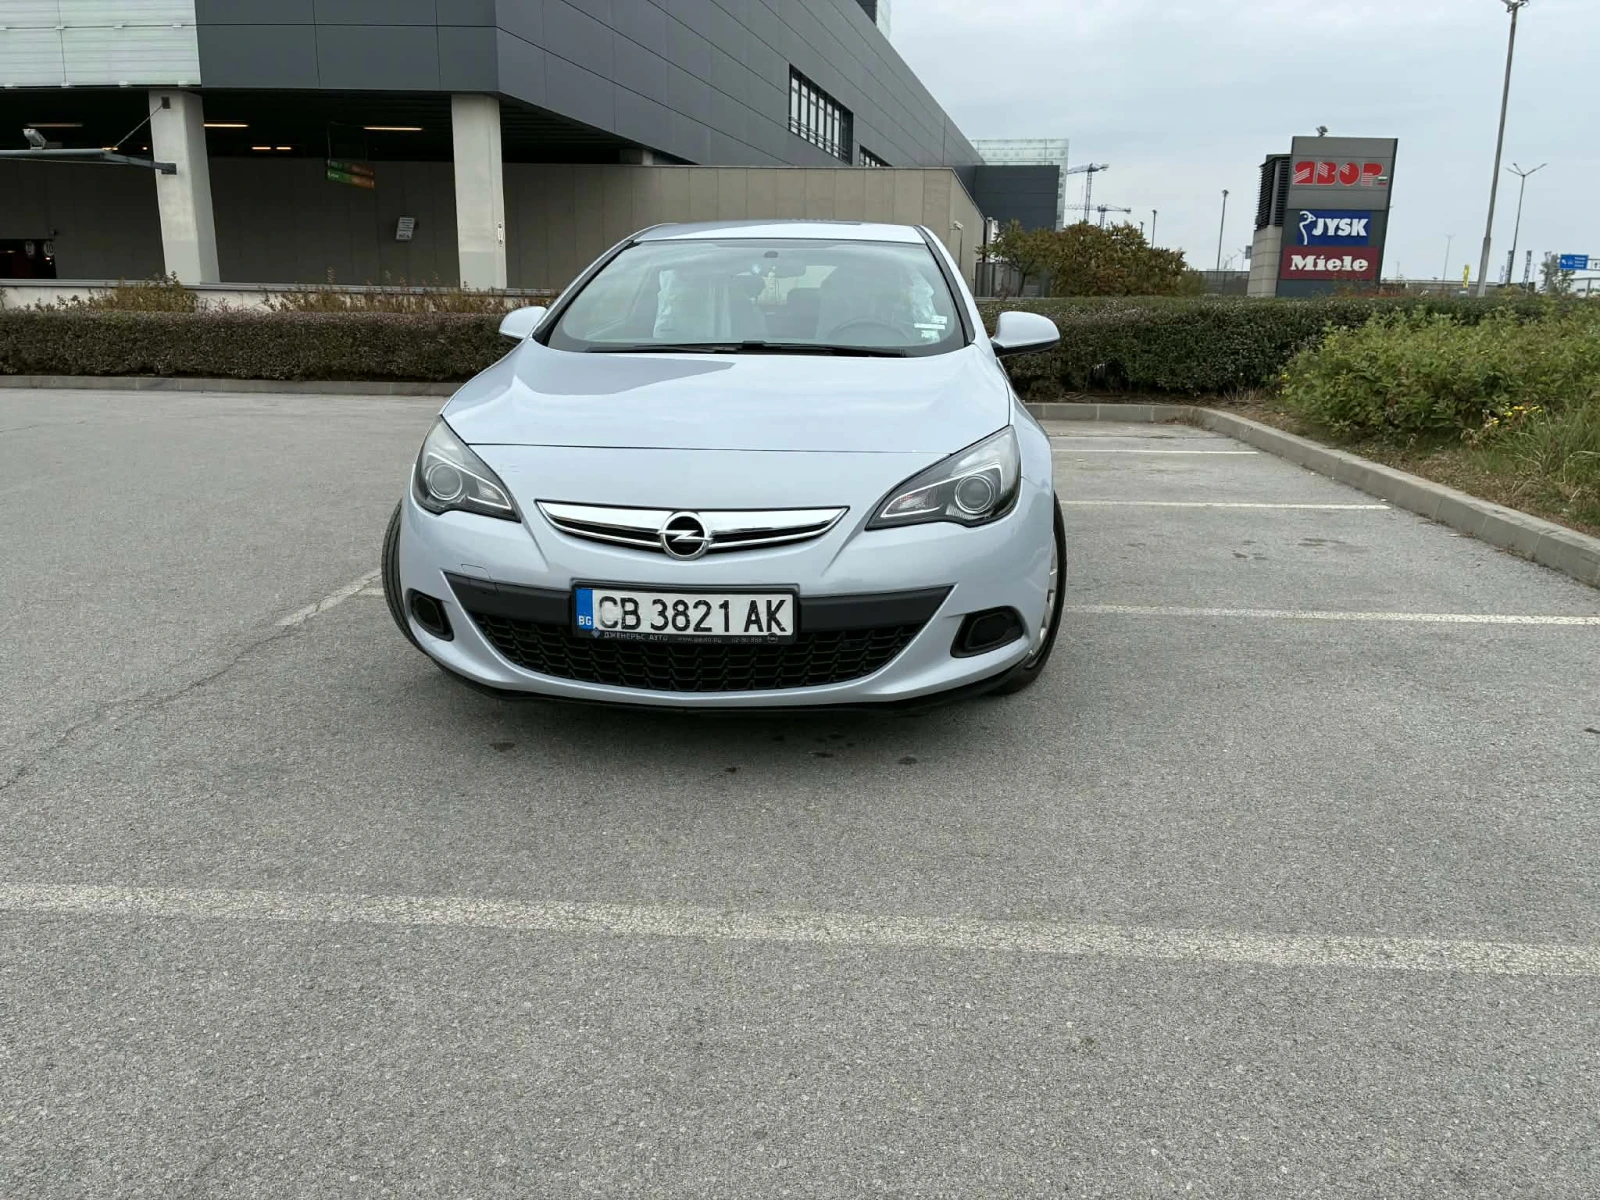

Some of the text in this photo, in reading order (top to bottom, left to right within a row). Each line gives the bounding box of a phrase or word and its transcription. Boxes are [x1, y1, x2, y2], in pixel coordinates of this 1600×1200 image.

[1312, 218, 1369, 237] JYSK
[1290, 255, 1369, 272] Miele
[578, 615, 592, 626] BG
[599, 596, 787, 633] CB 3821 AK
